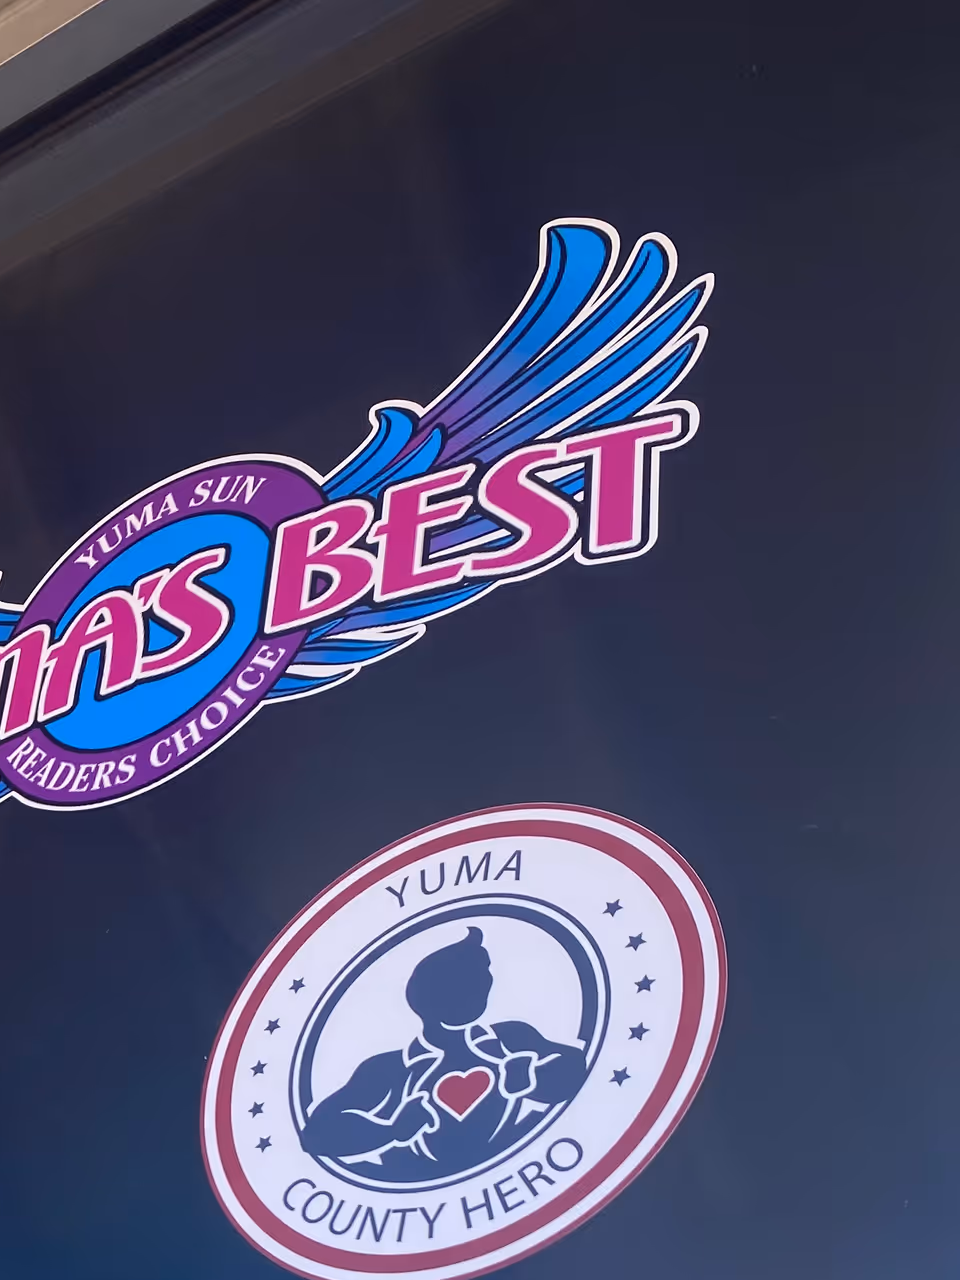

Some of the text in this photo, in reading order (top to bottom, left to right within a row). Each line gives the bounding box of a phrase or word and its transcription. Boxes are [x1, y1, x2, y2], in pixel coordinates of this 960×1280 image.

[74, 473, 268, 570] YUMA SUN
[267, 408, 690, 634] BEST
[7, 643, 288, 792] READERS CHOICE
[385, 849, 523, 908] YUMA
[282, 1136, 583, 1242] COUNTY HERO
